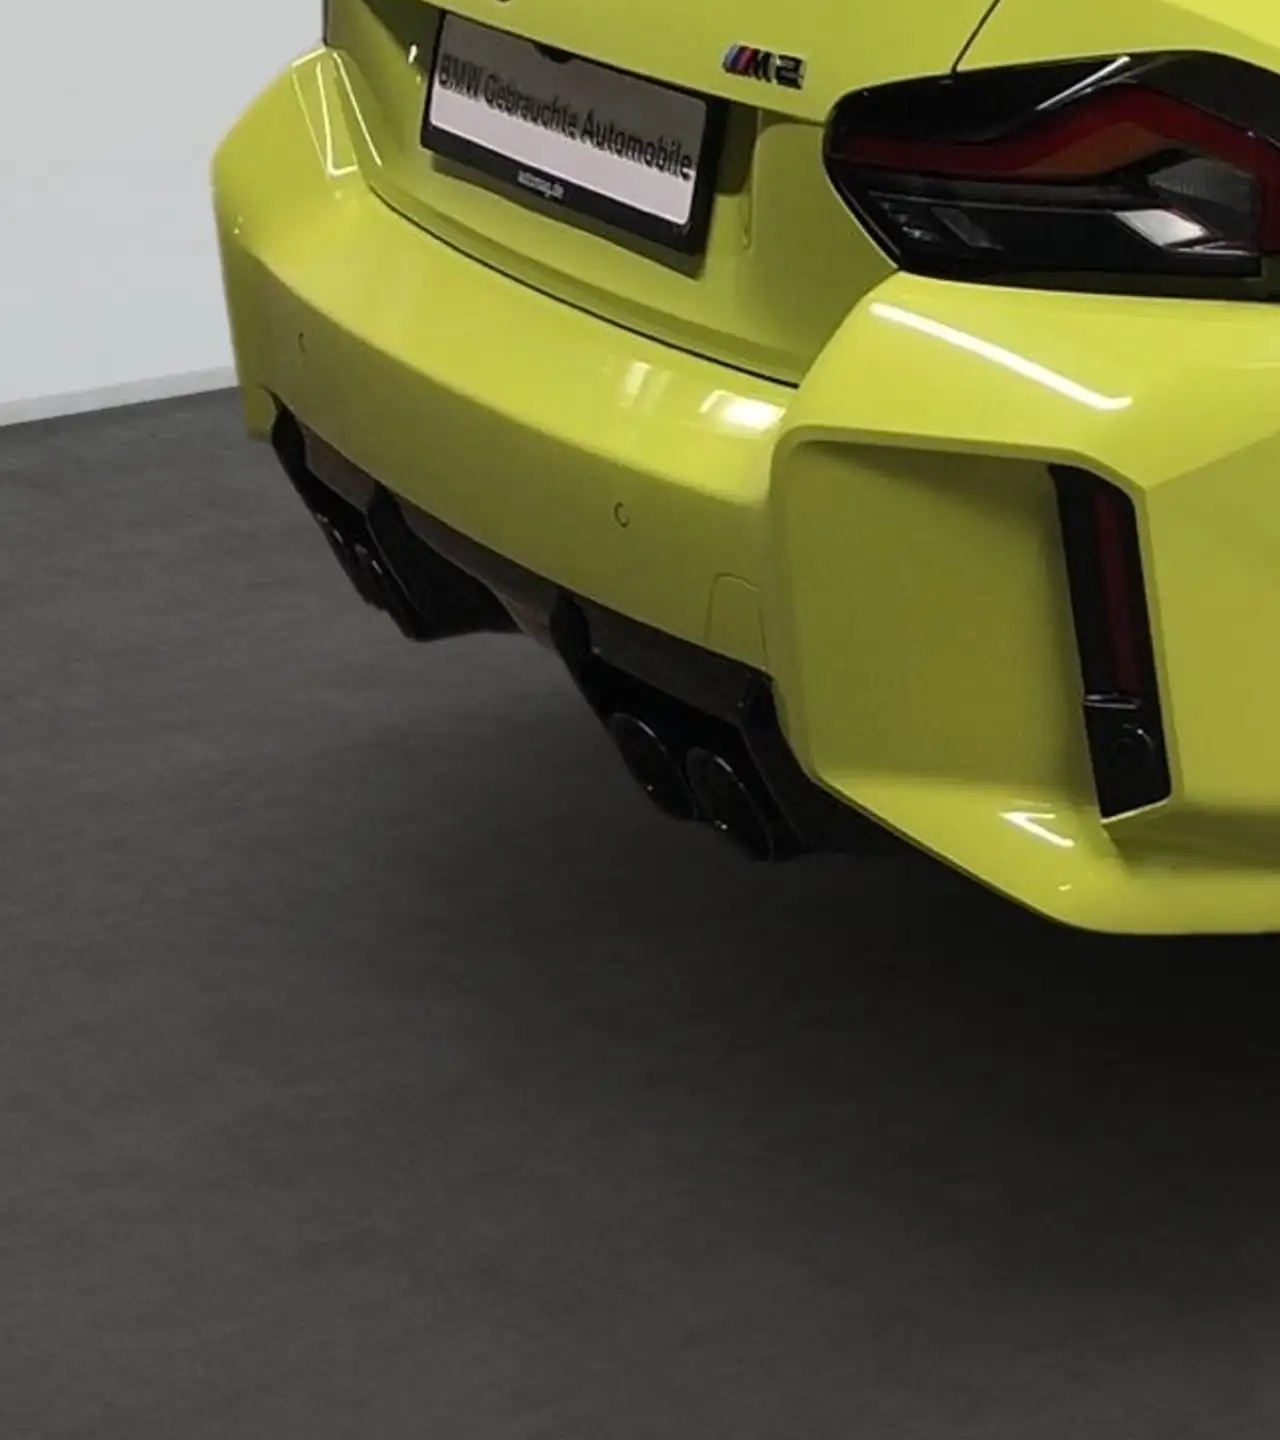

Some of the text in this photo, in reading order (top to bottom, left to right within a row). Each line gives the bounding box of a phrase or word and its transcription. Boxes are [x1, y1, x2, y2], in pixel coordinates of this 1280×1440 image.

[438, 54, 693, 182] BMW Gebrauchte Automobile
